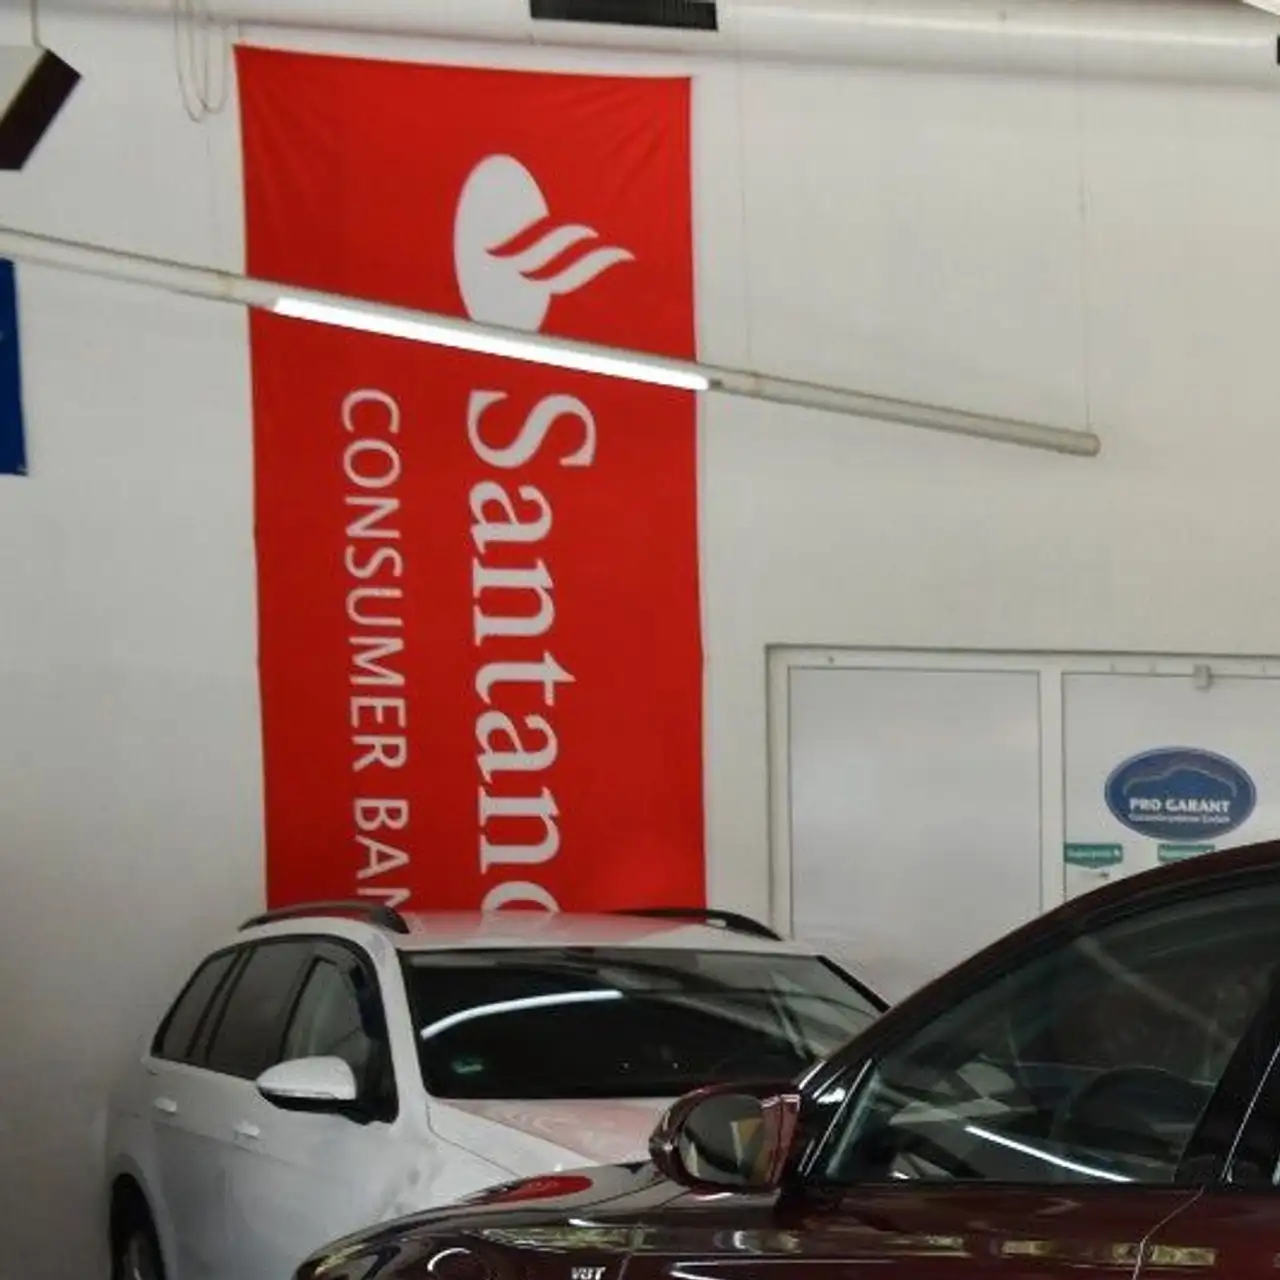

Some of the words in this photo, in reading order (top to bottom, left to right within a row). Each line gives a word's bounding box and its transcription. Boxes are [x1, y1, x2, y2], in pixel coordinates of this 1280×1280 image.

[341, 388, 408, 772] CONSUMER
[1129, 797, 1162, 812] PRO
[1166, 798, 1231, 813] GARANT
